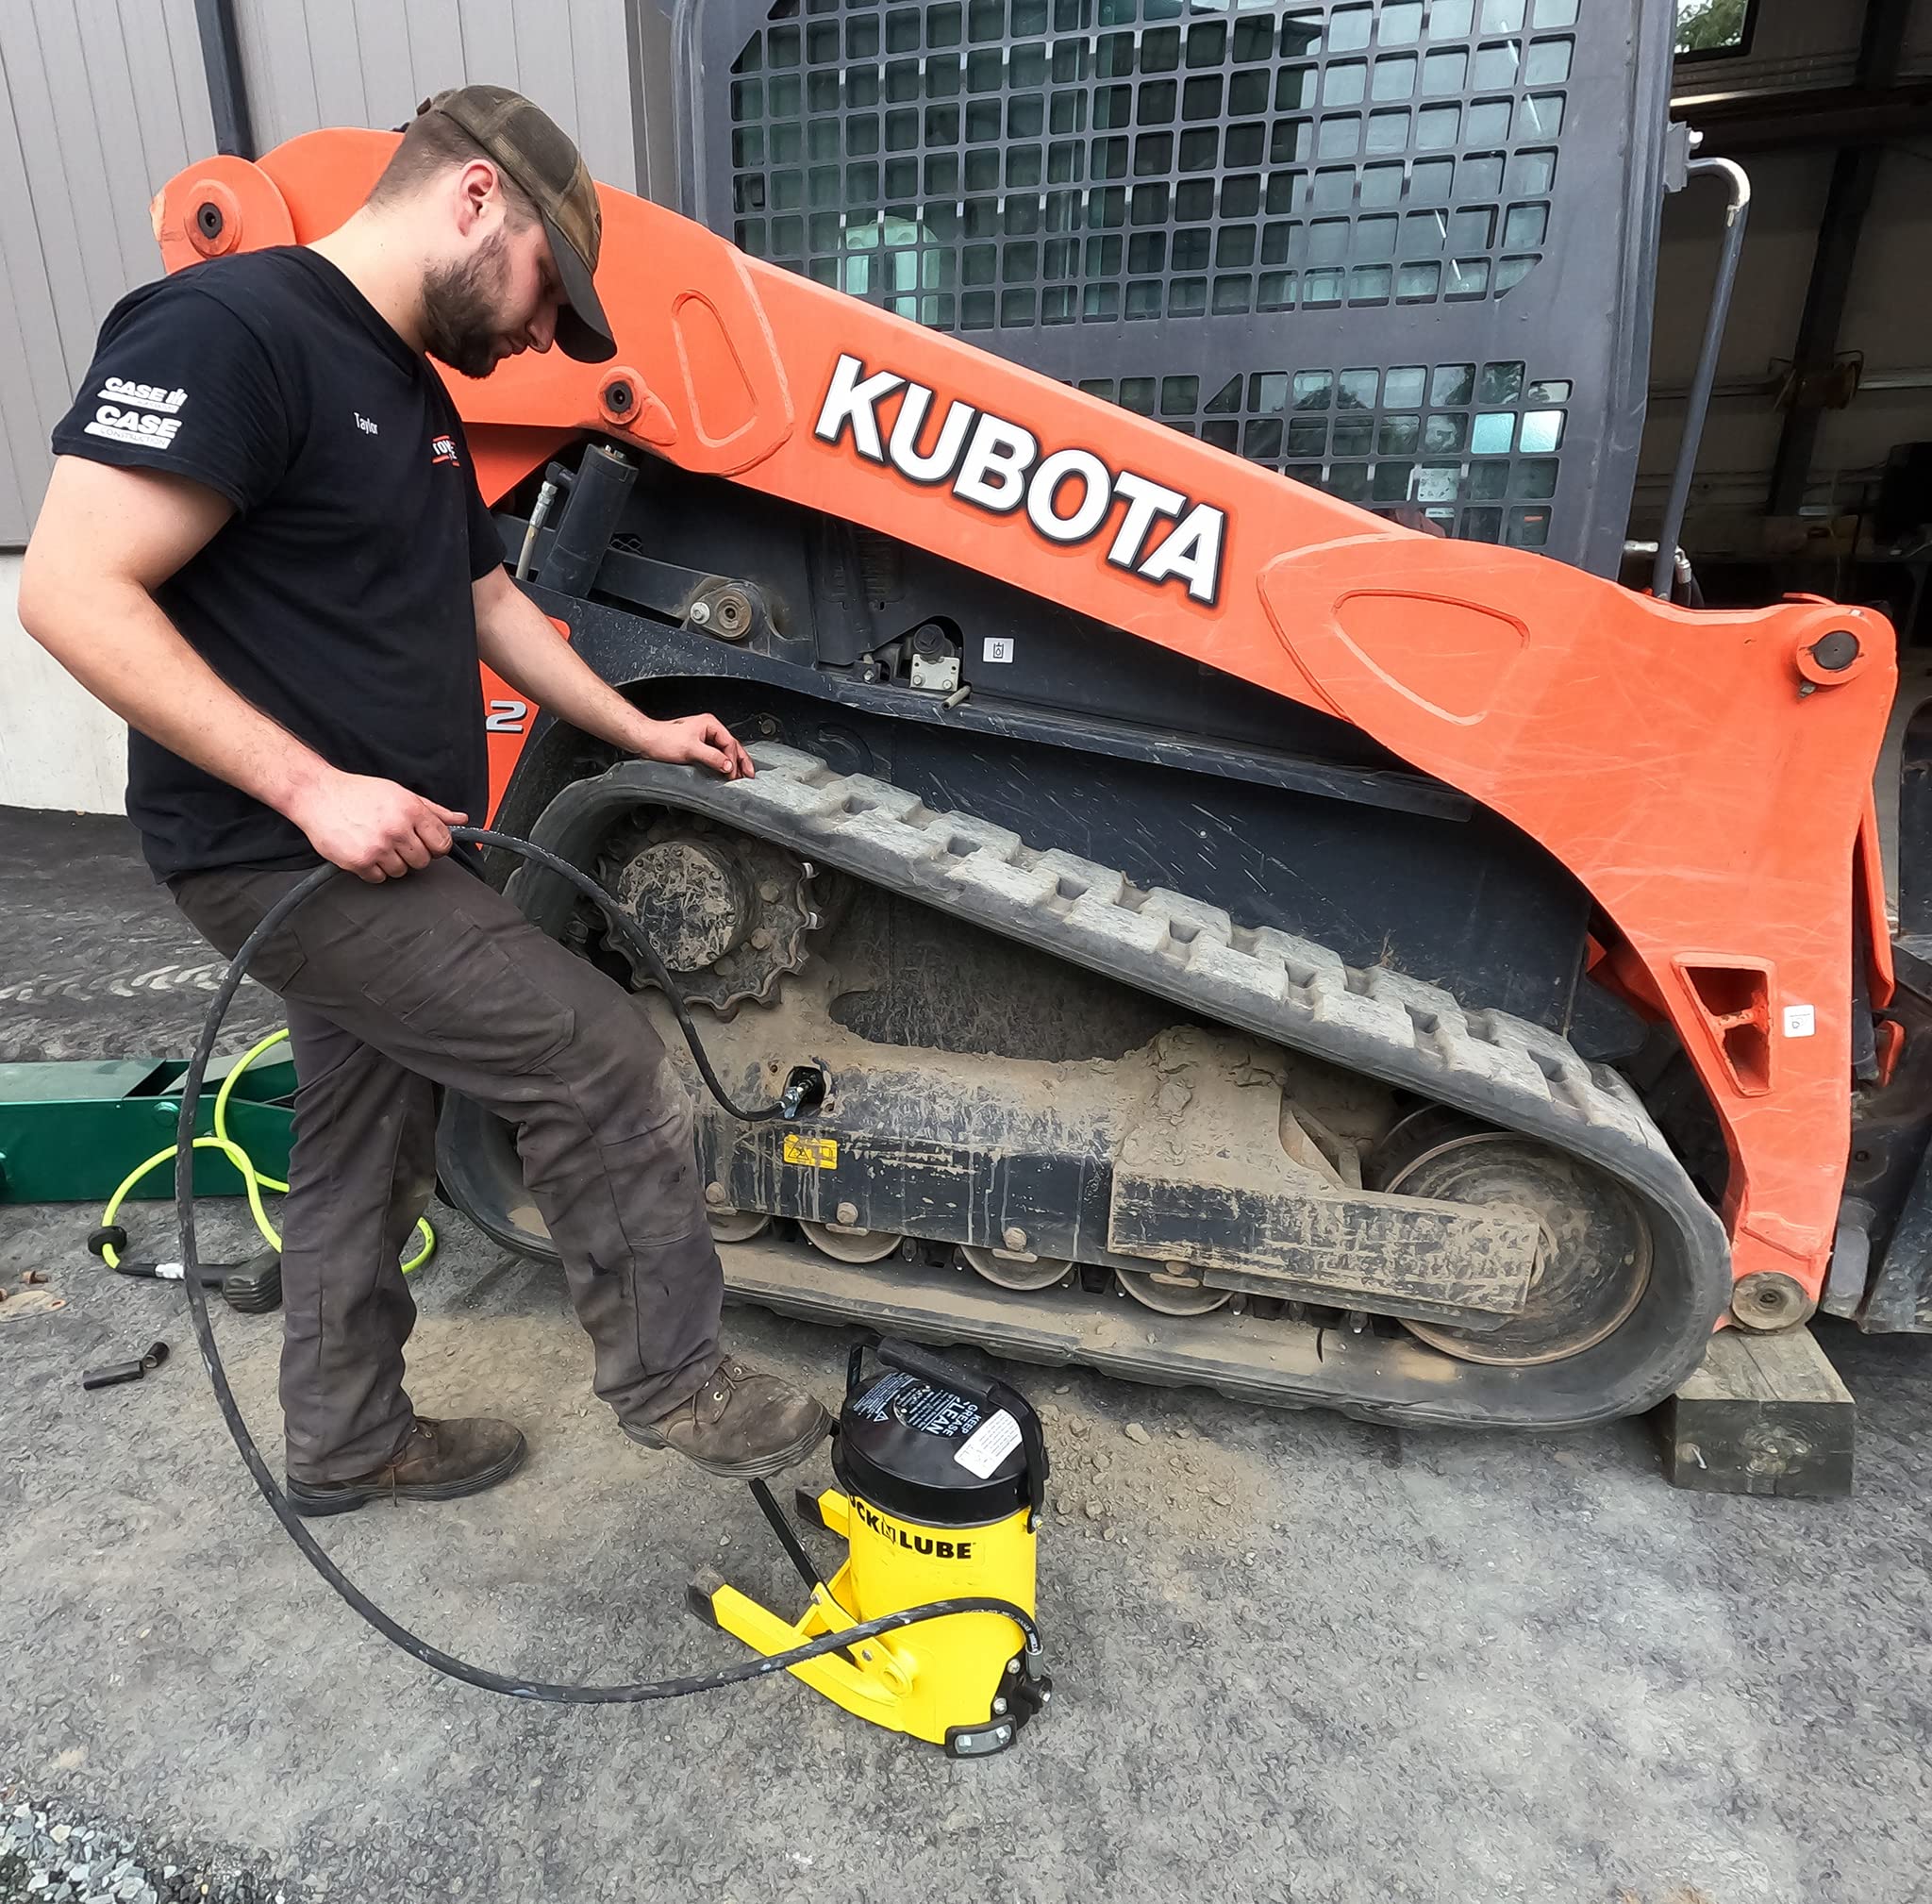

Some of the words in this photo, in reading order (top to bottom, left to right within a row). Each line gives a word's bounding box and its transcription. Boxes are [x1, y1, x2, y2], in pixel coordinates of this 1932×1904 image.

[105, 376, 168, 402] CASE
[95, 405, 183, 439] CASE
[354, 412, 378, 434] Taylor
[100, 427, 167, 446] CONSTRUCTION
[814, 352, 1225, 605] KUBOTA
[941, 1404, 978, 1437] GREASE
[961, 1413, 982, 1434] KEEP
[899, 1529, 972, 1560] LUBE
